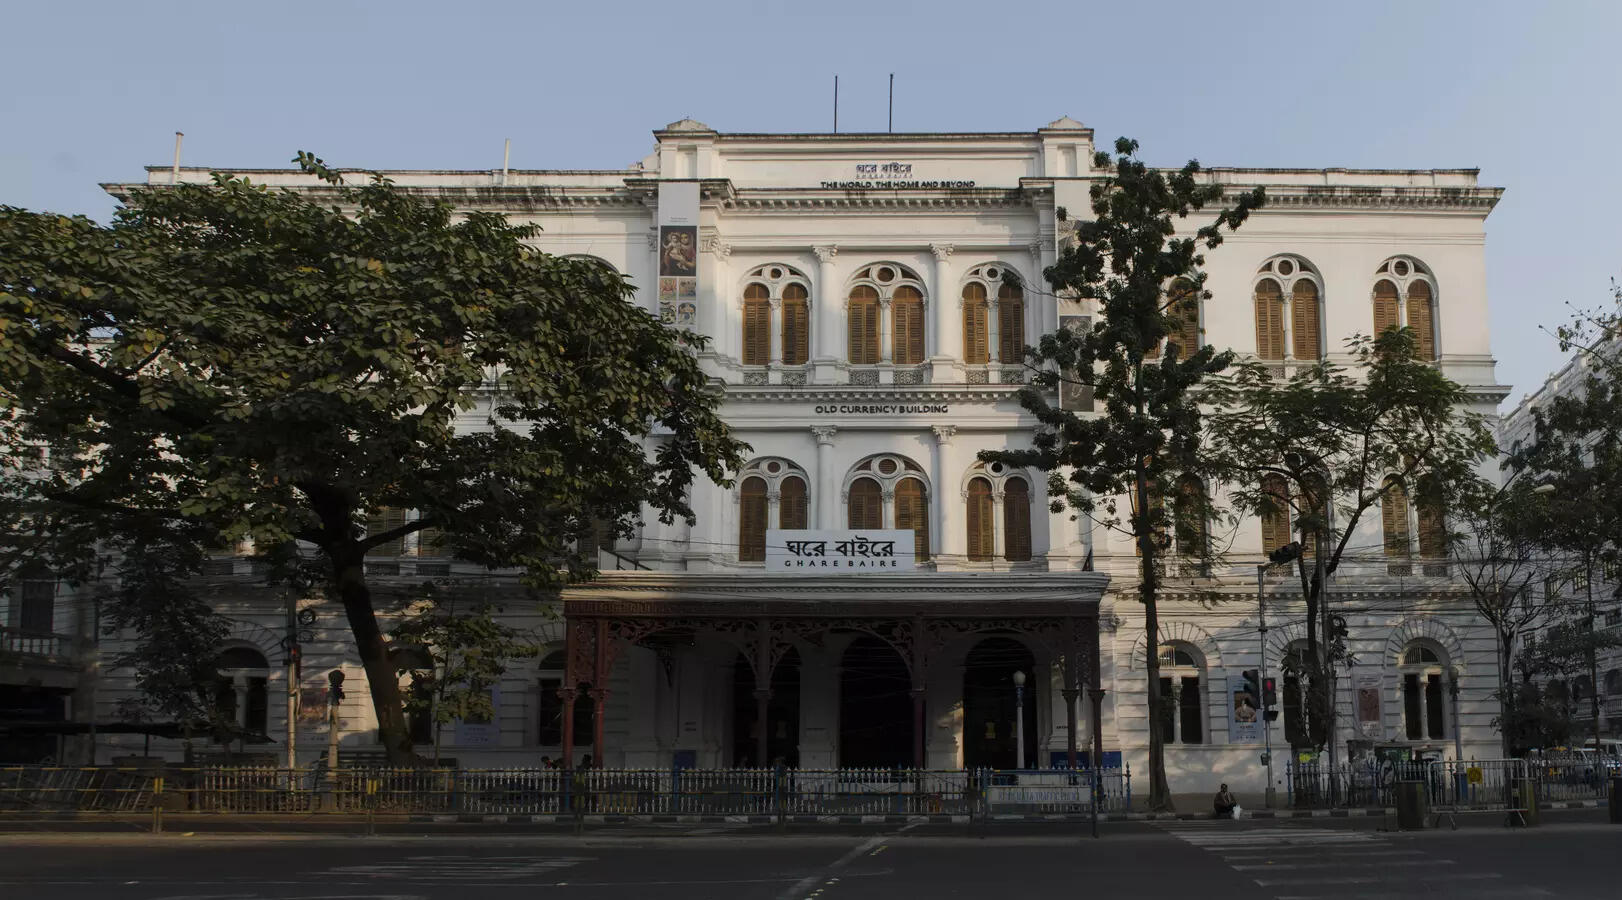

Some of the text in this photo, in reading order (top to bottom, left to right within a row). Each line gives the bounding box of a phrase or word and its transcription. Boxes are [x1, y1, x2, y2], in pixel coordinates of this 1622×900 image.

[856, 164, 877, 173] ঘরে
[820, 181, 975, 189] THE WORLD, THE HOME AND BEYOND
[815, 405, 948, 414] OLD CURRENCY BUILDING
[785, 535, 895, 558] ঘরে বাইরে
